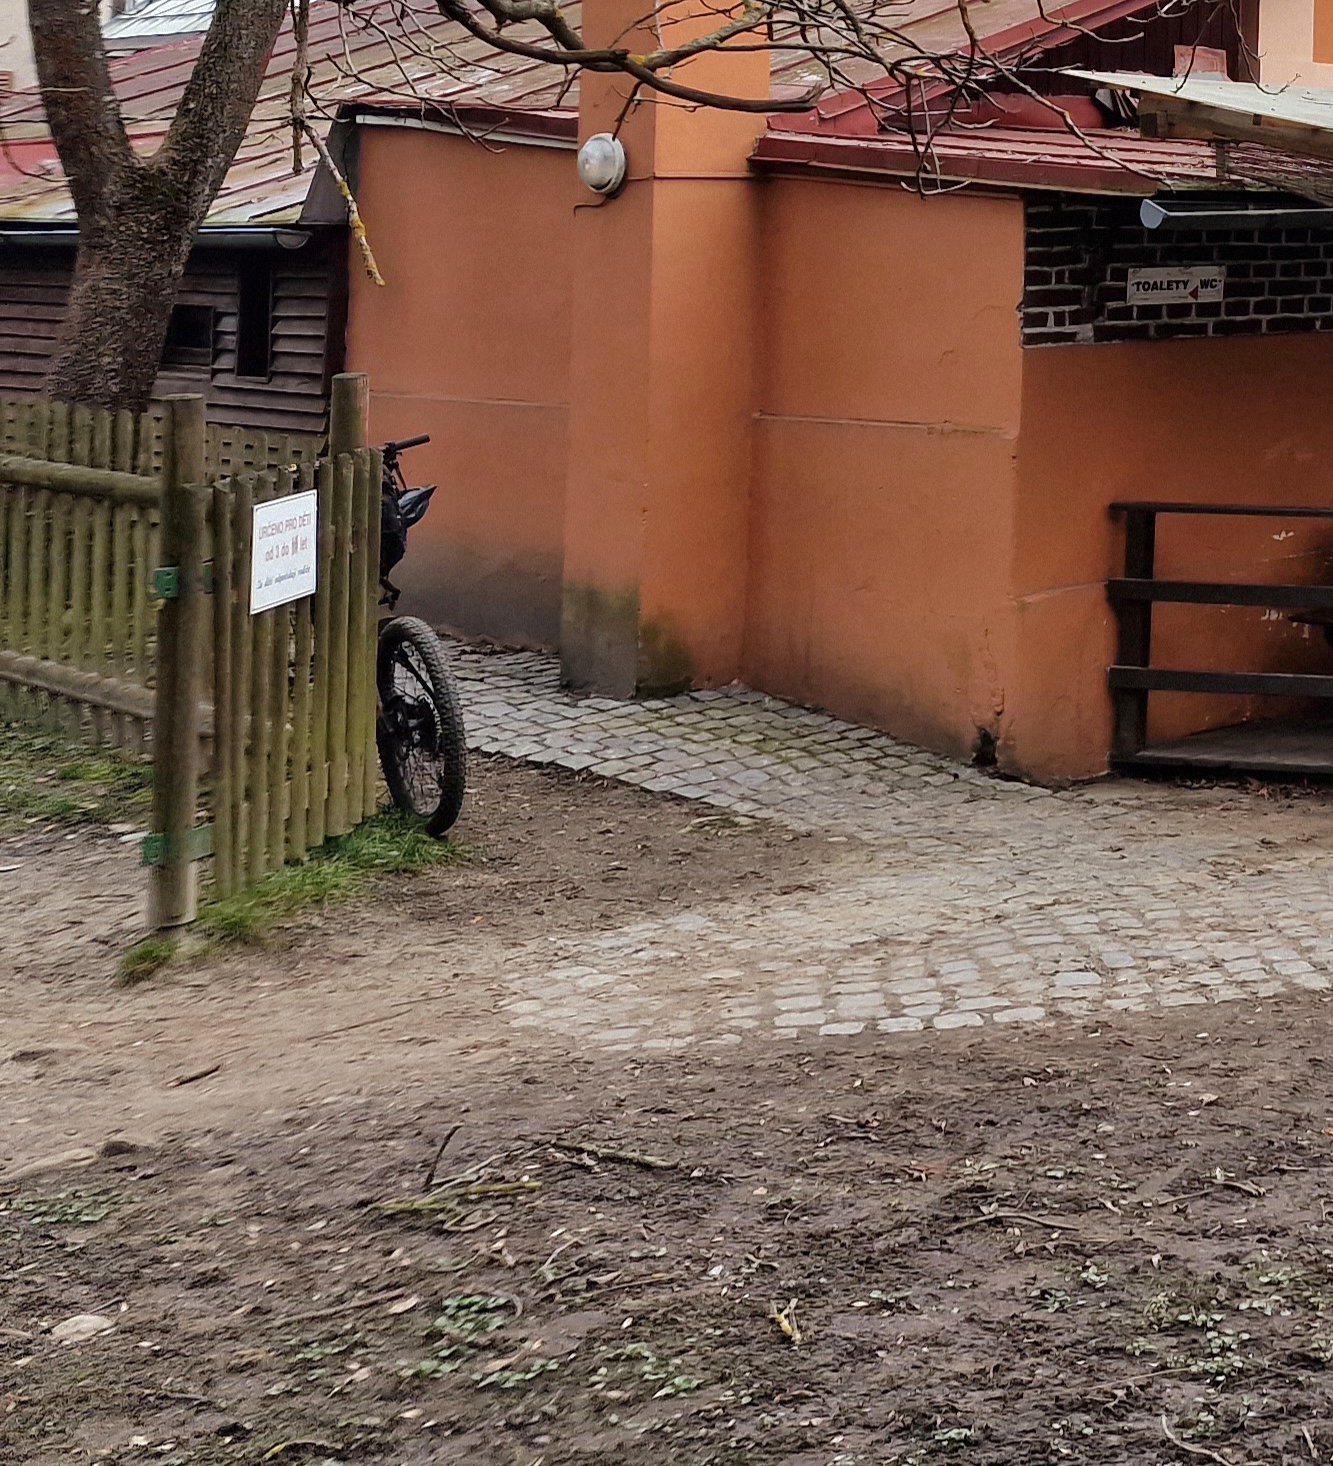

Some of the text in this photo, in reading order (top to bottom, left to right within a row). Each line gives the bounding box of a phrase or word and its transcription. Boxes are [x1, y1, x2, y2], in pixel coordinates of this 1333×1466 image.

[1132, 278, 1219, 292] TOALETY WC
[285, 517, 297, 532] PRO
[265, 546, 274, 561] od
[275, 545, 280, 558] 3
[281, 542, 288, 557] do
[299, 537, 307, 550] let
